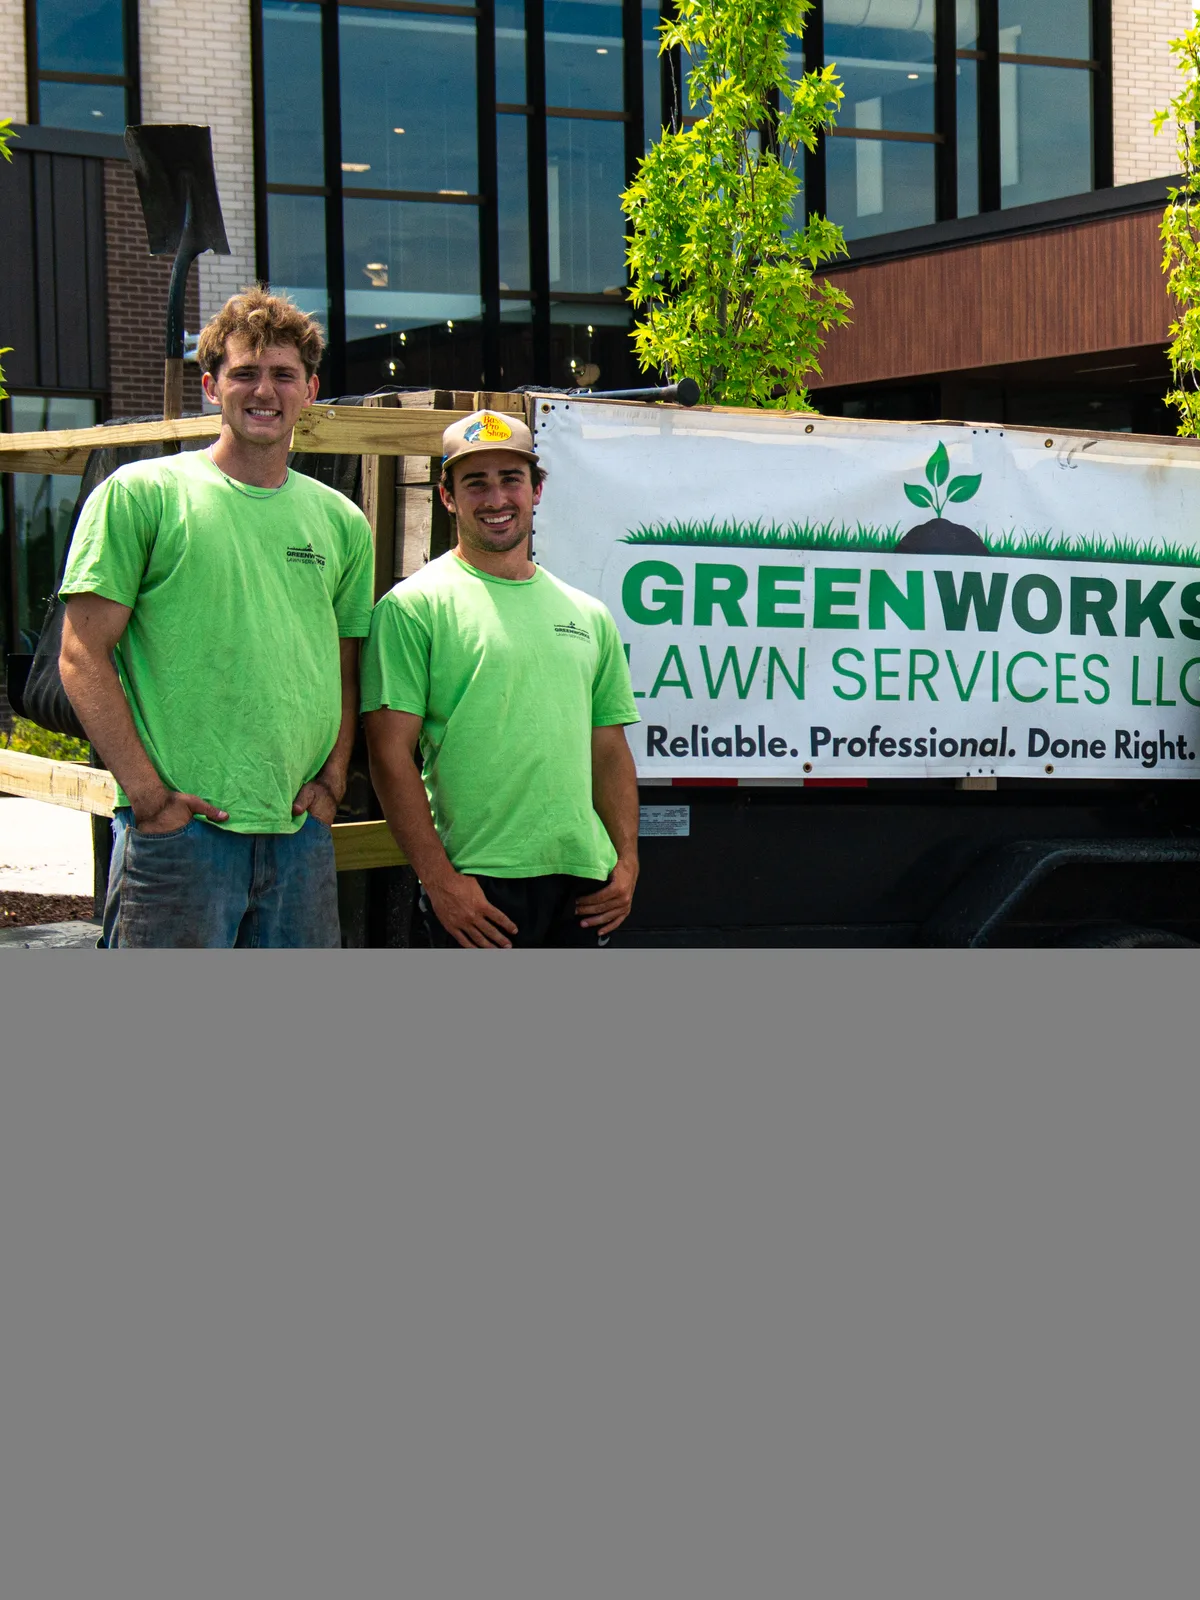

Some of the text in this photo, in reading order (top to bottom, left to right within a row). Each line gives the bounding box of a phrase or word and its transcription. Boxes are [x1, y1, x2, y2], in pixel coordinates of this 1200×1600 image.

[623, 643, 806, 700] LAWN
[831, 647, 1110, 705] SERVICES
[646, 724, 1196, 768] Reliable. Professional. Done Right.
